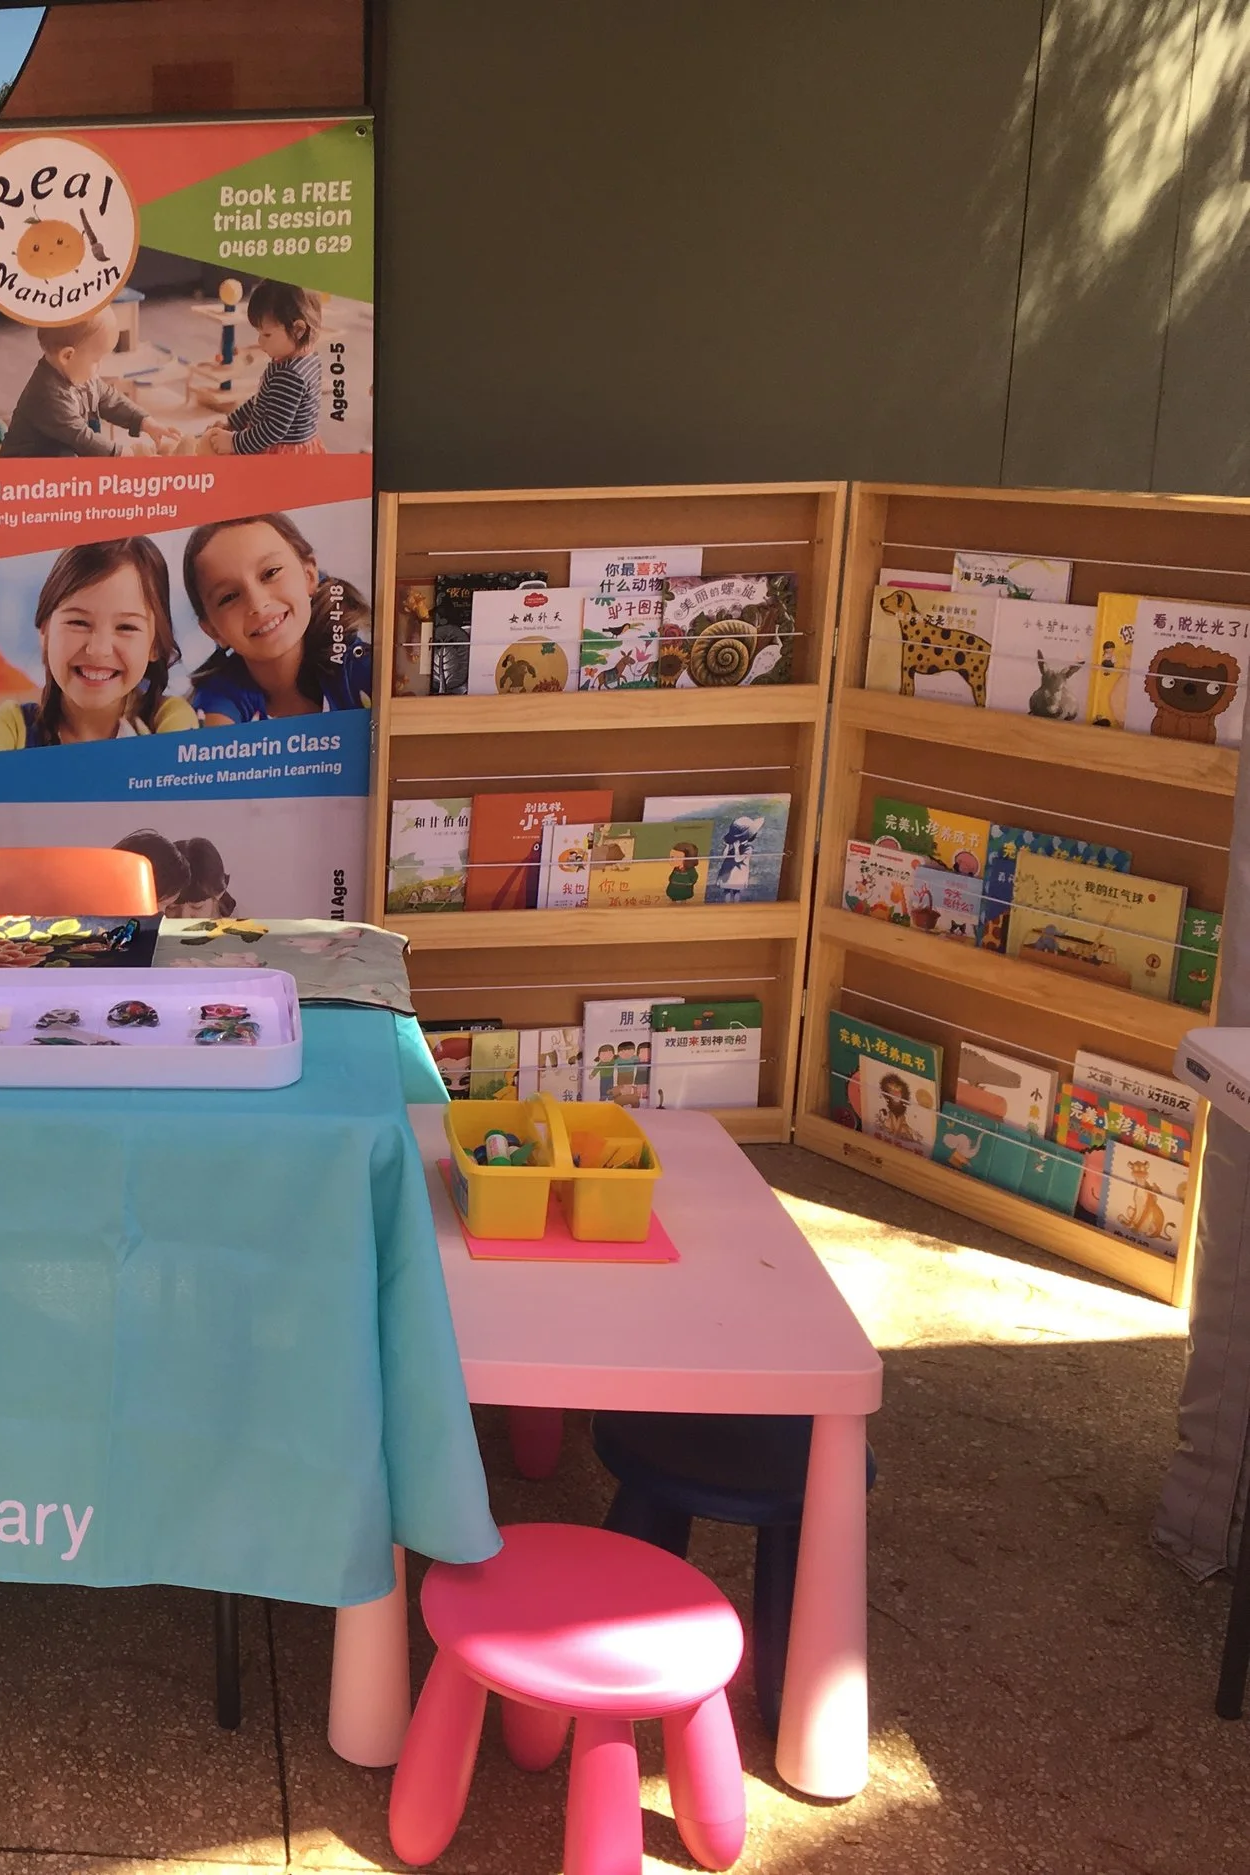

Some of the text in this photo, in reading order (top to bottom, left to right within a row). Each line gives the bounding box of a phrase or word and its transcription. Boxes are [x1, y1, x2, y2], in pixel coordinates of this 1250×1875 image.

[220, 180, 353, 207] Book a FREE
[213, 206, 352, 232] trial session
[218, 235, 352, 258] 0468 880 629
[330, 342, 346, 422] Ages 0-5
[98, 472, 215, 498] Playgroup
[21, 508, 82, 524] learning
[85, 504, 144, 520] through
[147, 503, 178, 518] play
[605, 562, 667, 576] 你最喜欢
[960, 571, 1009, 585] 海马先生
[600, 578, 663, 593] 什么动物
[330, 585, 347, 665] Ages 4-18
[177, 734, 341, 763] Mandarin Class
[128, 762, 342, 789] Fun Effective Mandarin Learning
[331, 869, 347, 921] ll Ages
[1084, 880, 1144, 905] 我的红气球
